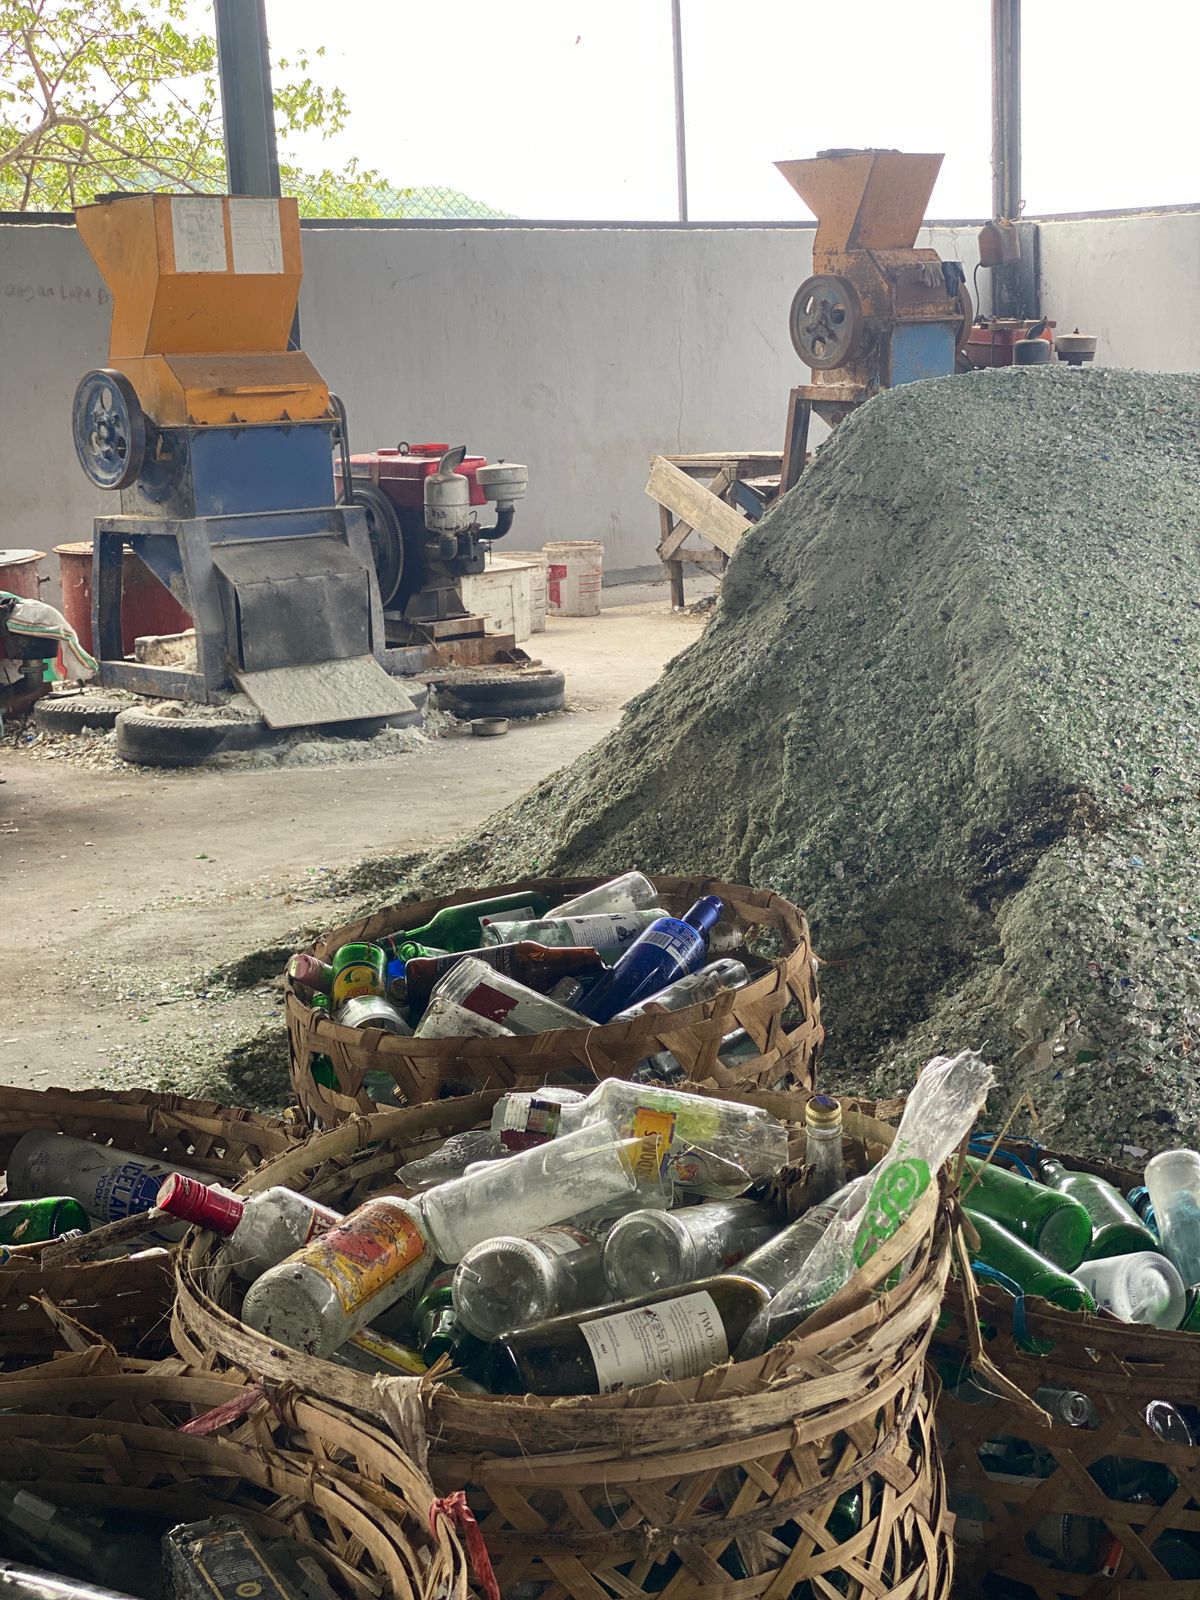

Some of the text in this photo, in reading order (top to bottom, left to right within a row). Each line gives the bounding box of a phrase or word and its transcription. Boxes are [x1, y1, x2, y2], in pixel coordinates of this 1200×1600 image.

[93, 1174, 107, 1208] VODKA
[109, 1161, 145, 1220] ICELAN
[697, 1306, 716, 1339] TWO
